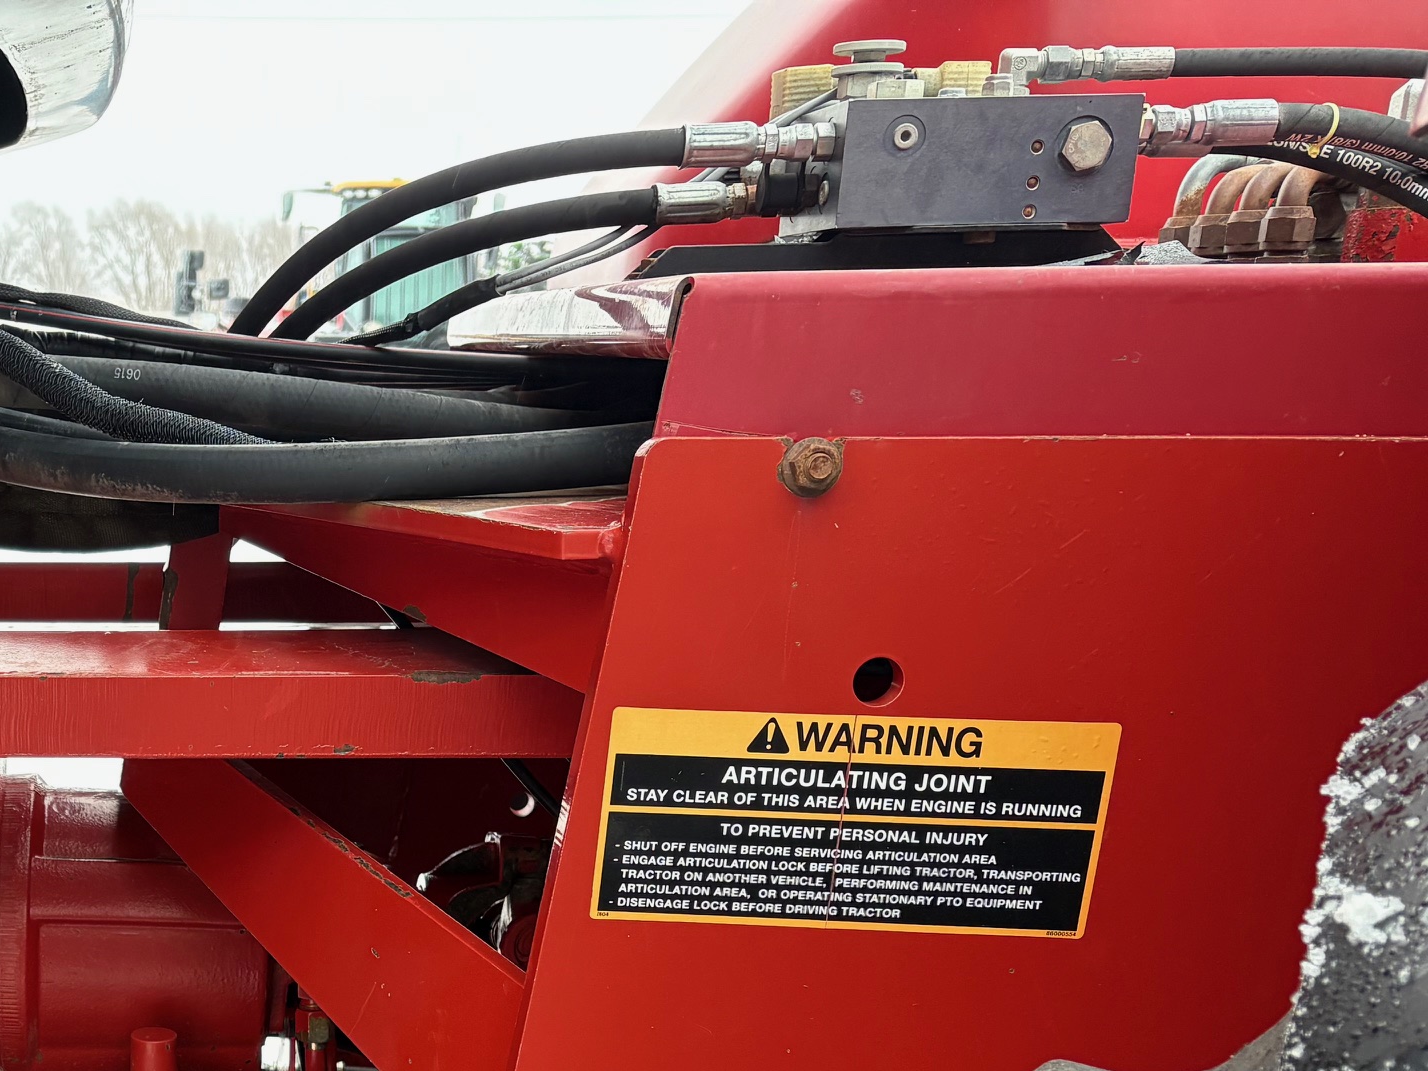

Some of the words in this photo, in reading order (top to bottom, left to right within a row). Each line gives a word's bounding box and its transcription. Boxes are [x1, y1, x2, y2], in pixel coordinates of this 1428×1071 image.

[1336, 149, 1383, 176] 100R2
[114, 367, 142, 381] 0615
[796, 721, 983, 759] WARNING
[721, 765, 907, 791] ARTICULATING
[914, 773, 992, 794] JOINT
[626, 787, 669, 802] STAY
[672, 789, 729, 805] CLEAR
[733, 792, 758, 805] OF
[761, 793, 800, 807] THIS
[803, 794, 851, 809] AREA
[855, 797, 906, 812] WHEN
[910, 799, 976, 814] ENGINE
[980, 801, 997, 815] IS
[1001, 802, 1082, 818] RUNNING
[720, 822, 743, 837] TO
[747, 824, 826, 840] PREVENT
[829, 826, 920, 844] PERSONAL
[925, 831, 989, 846] INJURY
[623, 840, 659, 851] SHUT
[661, 841, 687, 852] OFF
[688, 842, 738, 855] ENGINE
[740, 845, 792, 857] BEFORE
[793, 846, 863, 860] SERVICING
[865, 850, 959, 864] ARTICULATION
[961, 854, 997, 865] AREA
[620, 868, 681, 881] TRACTOR
[683, 871, 703, 882] ON
[705, 872, 767, 884] ANOTHER
[770, 874, 827, 889] VEHICLE,
[834, 877, 919, 891] PERFORMING
[922, 881, 1016, 895] MAINTENANCE
[1018, 885, 1033, 895] IN
[622, 854, 675, 866] ENGAGE
[676, 856, 769, 870] ARTICULATION
[771, 860, 807, 872] LOCK
[809, 862, 860, 876] BEFORE
[862, 864, 911, 876] LIFTING
[914, 866, 978, 880] TRACTOR,
[981, 869, 1081, 883] TRANSPORTING
[617, 897, 691, 910] DISENGAGE
[693, 900, 729, 911] LOCK
[731, 901, 783, 913] BEFORE
[785, 904, 838, 917] DRIVING
[841, 906, 901, 919] TRACTOR
[618, 882, 711, 896] ARTICULATION
[712, 886, 751, 900] AREA,
[758, 888, 777, 899] OR
[780, 889, 853, 904] OPERATING
[855, 892, 935, 906] STATIONARY
[936, 896, 963, 907] PTO
[965, 897, 1043, 910] EQUIPMENT
